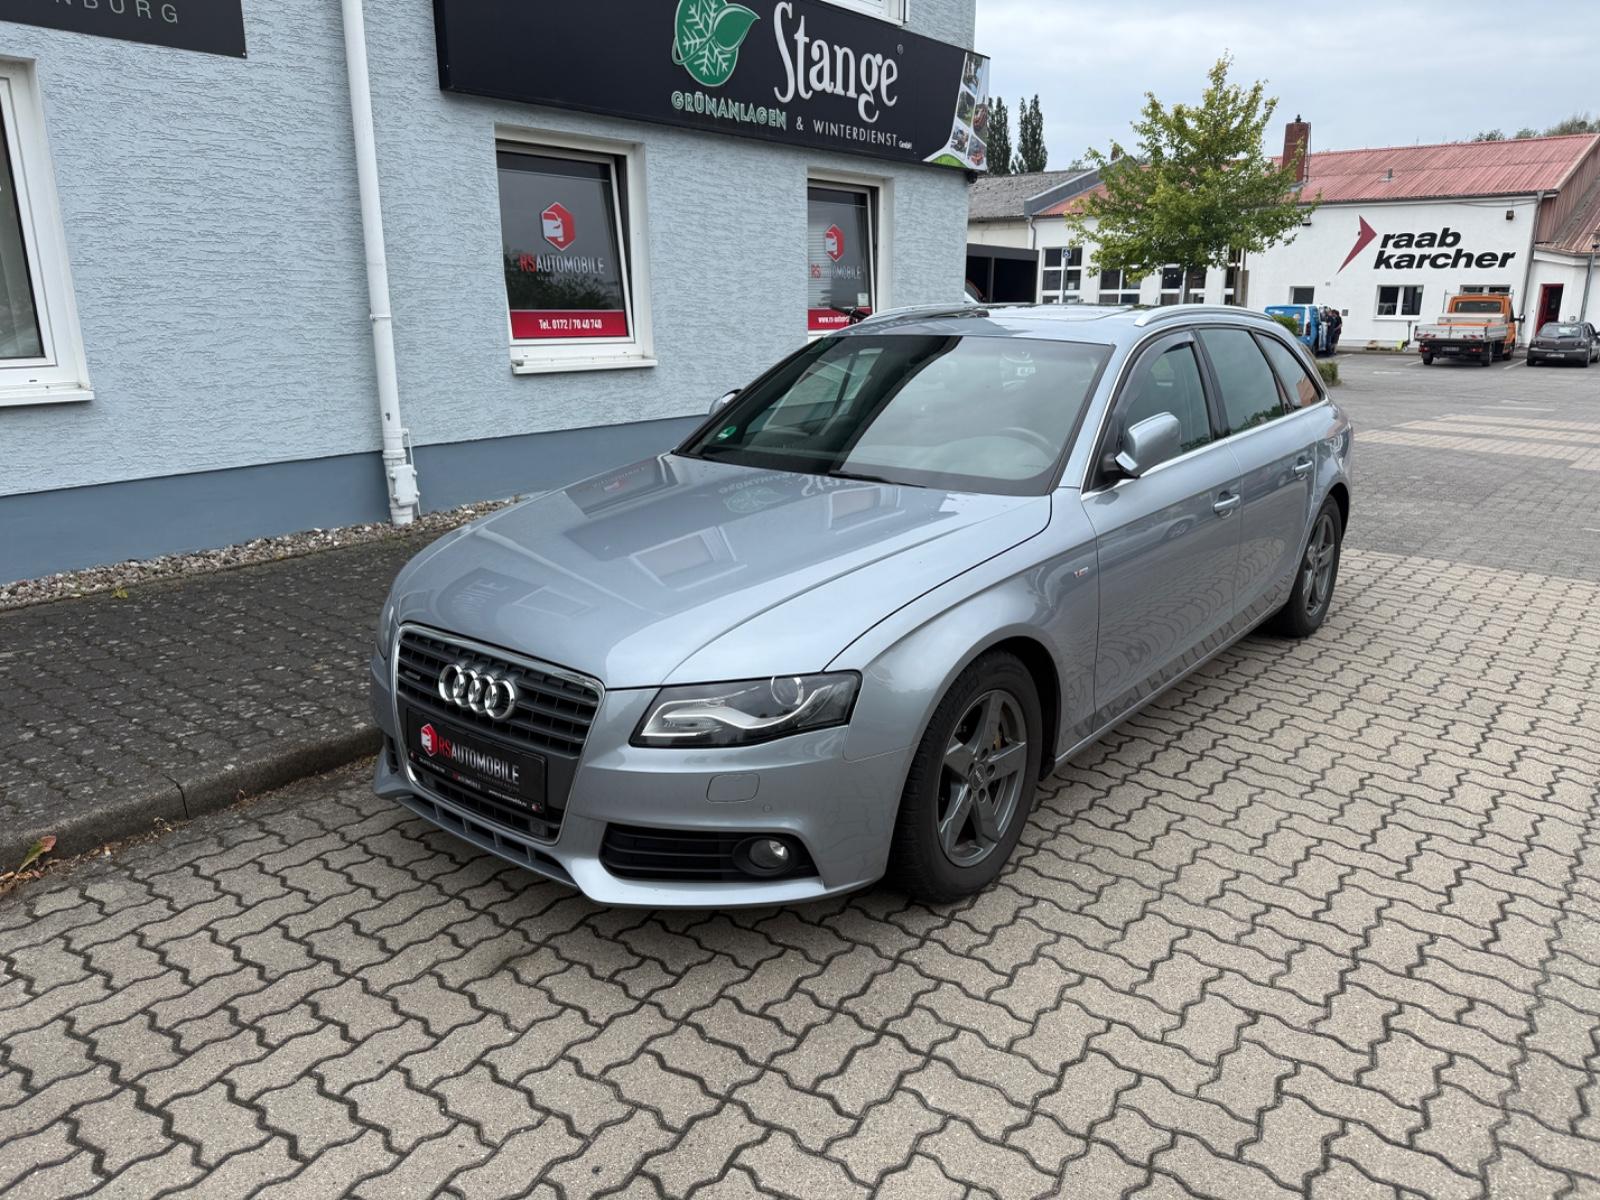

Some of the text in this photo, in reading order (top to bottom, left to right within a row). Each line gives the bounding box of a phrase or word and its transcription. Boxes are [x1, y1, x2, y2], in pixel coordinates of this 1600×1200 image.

[774, 2, 898, 122] Stange
[672, 91, 787, 130] GRÜNANLAGEN
[796, 117, 804, 131] &
[813, 119, 897, 147] WINTERDIENST
[1380, 227, 1461, 249] raab
[1373, 249, 1516, 269] karcher
